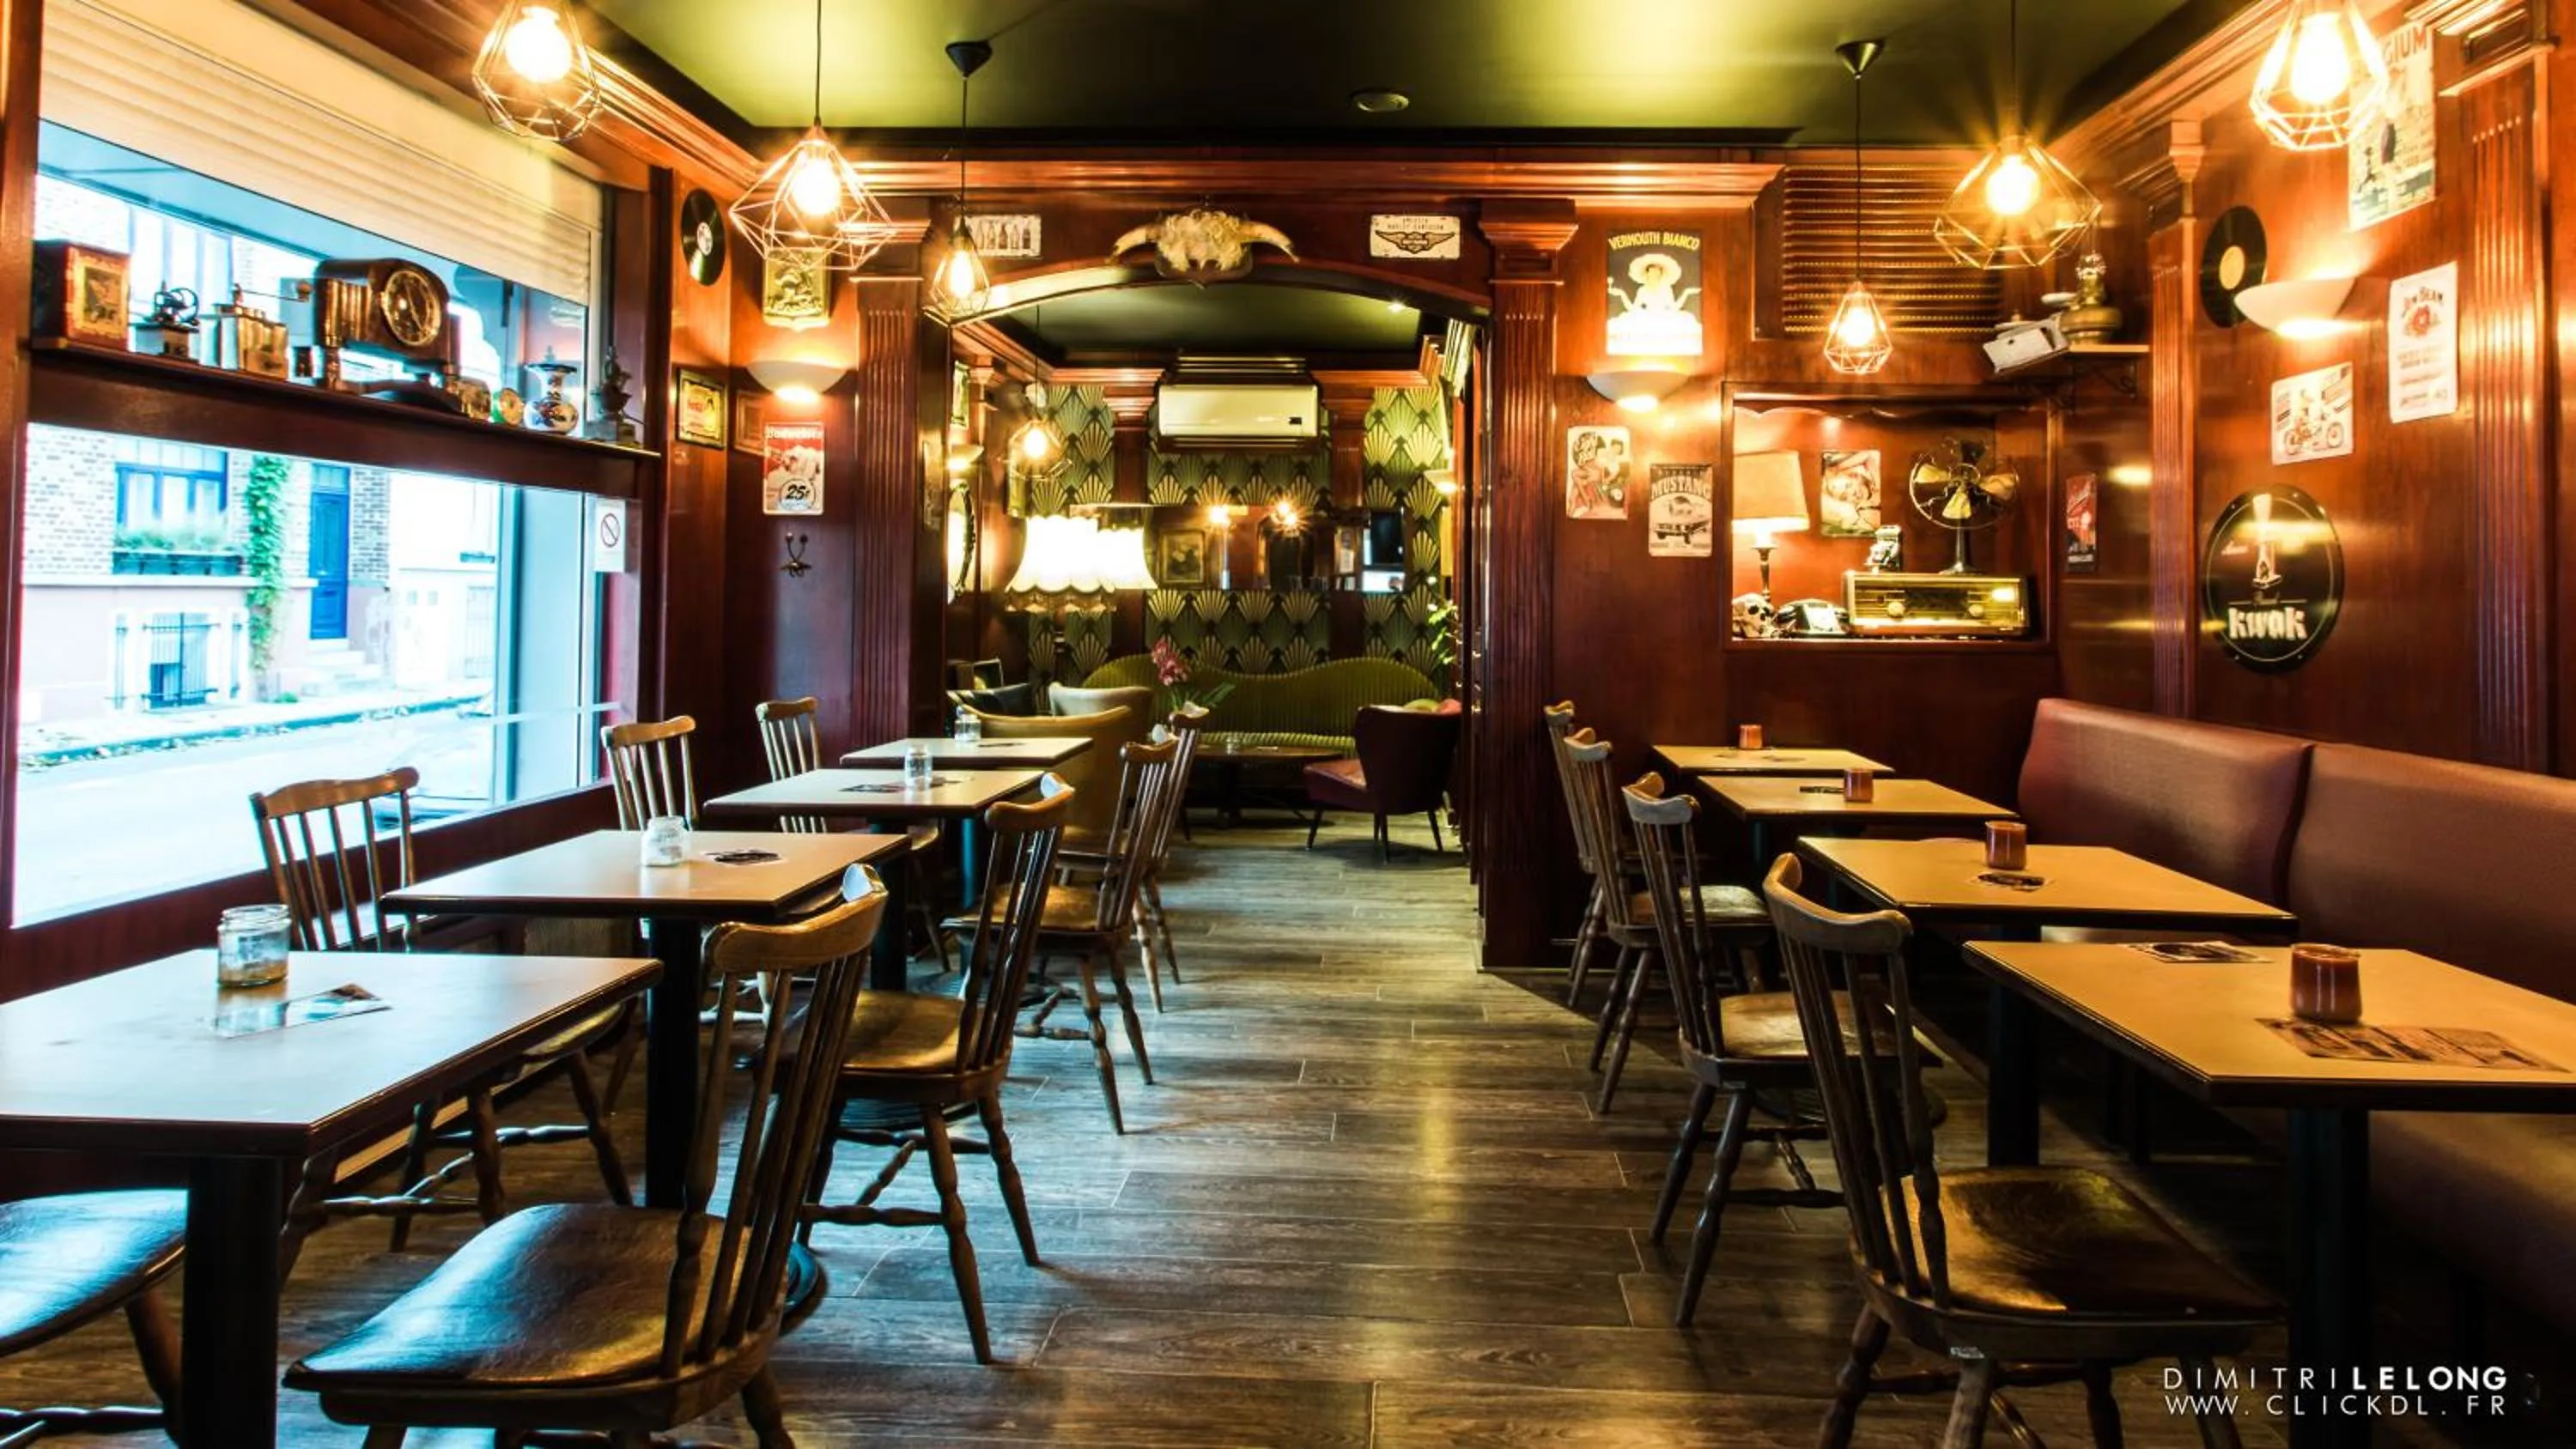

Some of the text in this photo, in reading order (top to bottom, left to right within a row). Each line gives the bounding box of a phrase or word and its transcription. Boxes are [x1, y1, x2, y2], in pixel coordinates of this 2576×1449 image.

[1607, 231, 1701, 251] VERMOUTH BIANCO
[1651, 476, 1712, 500] MUSTANG
